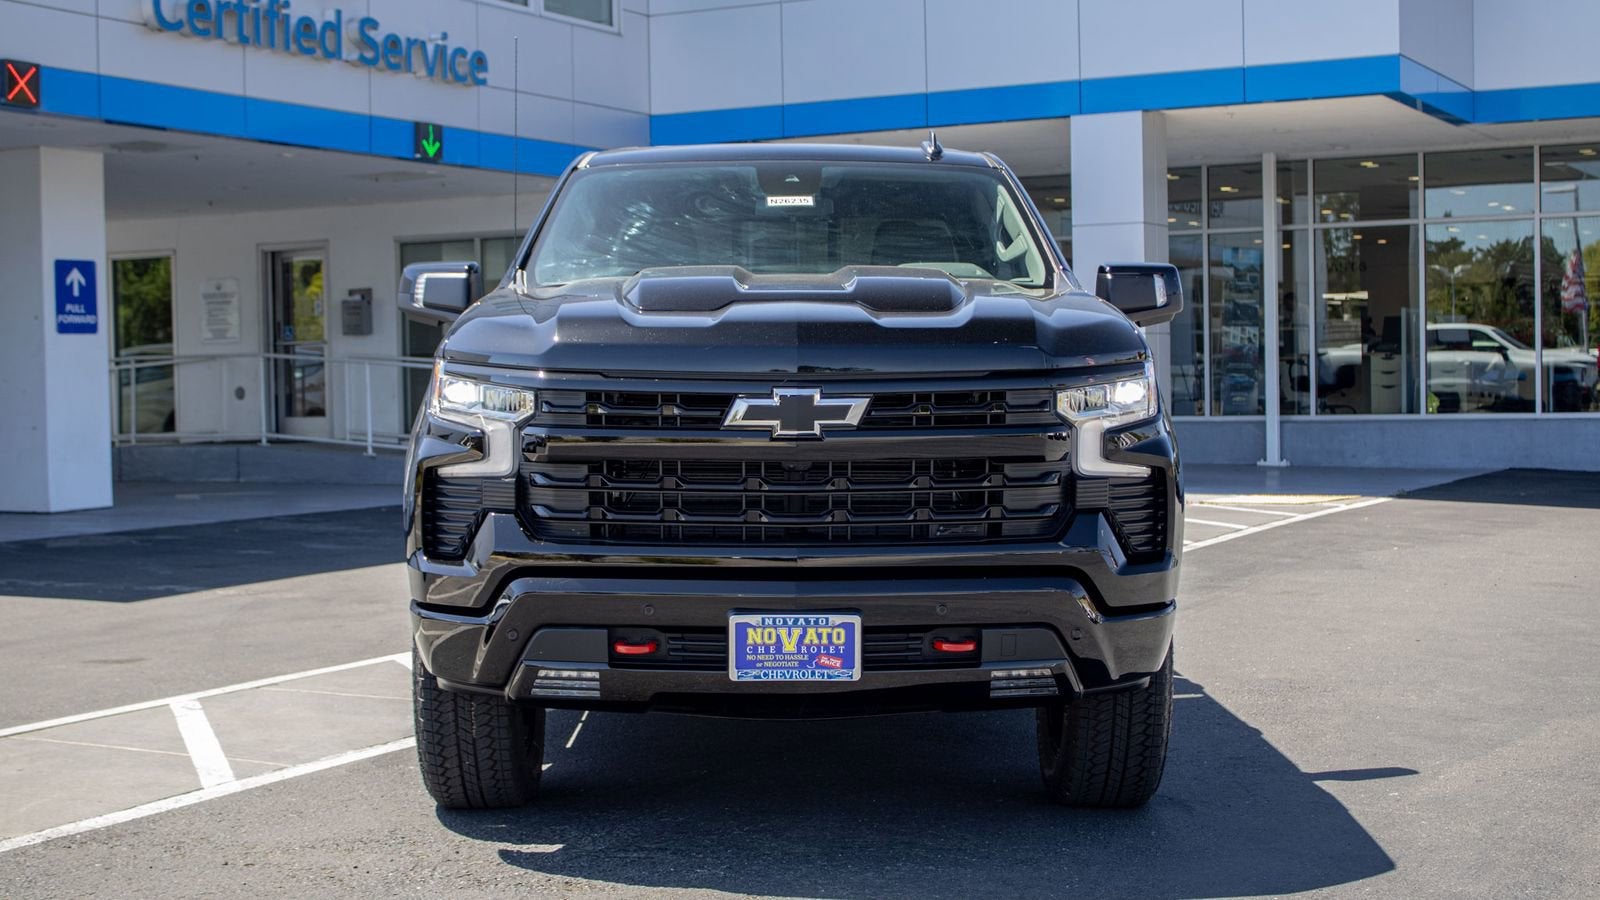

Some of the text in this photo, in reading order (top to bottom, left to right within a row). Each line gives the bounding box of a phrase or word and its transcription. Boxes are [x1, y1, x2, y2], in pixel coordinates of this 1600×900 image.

[153, 0, 489, 86] Certified Service
[65, 303, 86, 314] PULL
[57, 314, 97, 325] FORWARD
[764, 618, 827, 626] NOVATO
[746, 627, 846, 653] NOVATO
[760, 669, 828, 679] CHEVROLET
